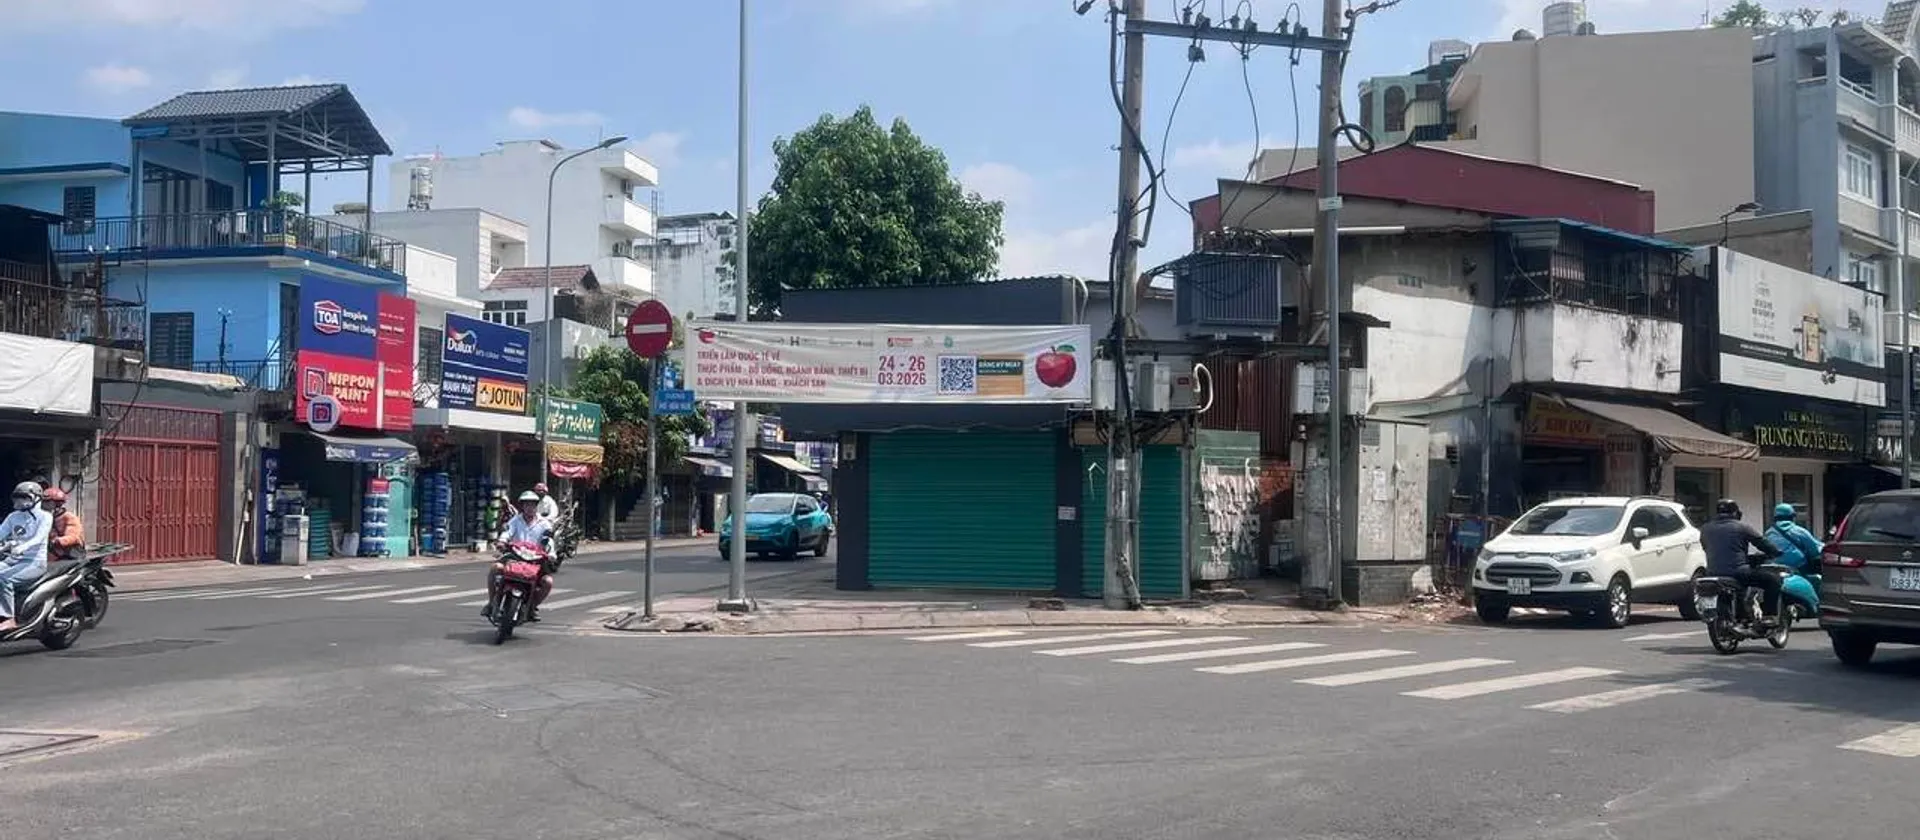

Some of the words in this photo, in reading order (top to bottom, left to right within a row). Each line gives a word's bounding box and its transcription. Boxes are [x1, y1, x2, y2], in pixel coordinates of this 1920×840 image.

[318, 310, 338, 325] TOA
[343, 308, 368, 322] Inspire
[342, 320, 359, 333] Better
[360, 324, 377, 337] Living
[447, 337, 474, 355] Dulux
[879, 356, 895, 371] 24
[909, 356, 925, 371] 26
[328, 371, 376, 390] NIPPON
[878, 372, 927, 386] 03.2026
[333, 386, 370, 403] PAINT
[490, 386, 524, 407] JOTUN
[1754, 424, 1793, 446] TRUNG
